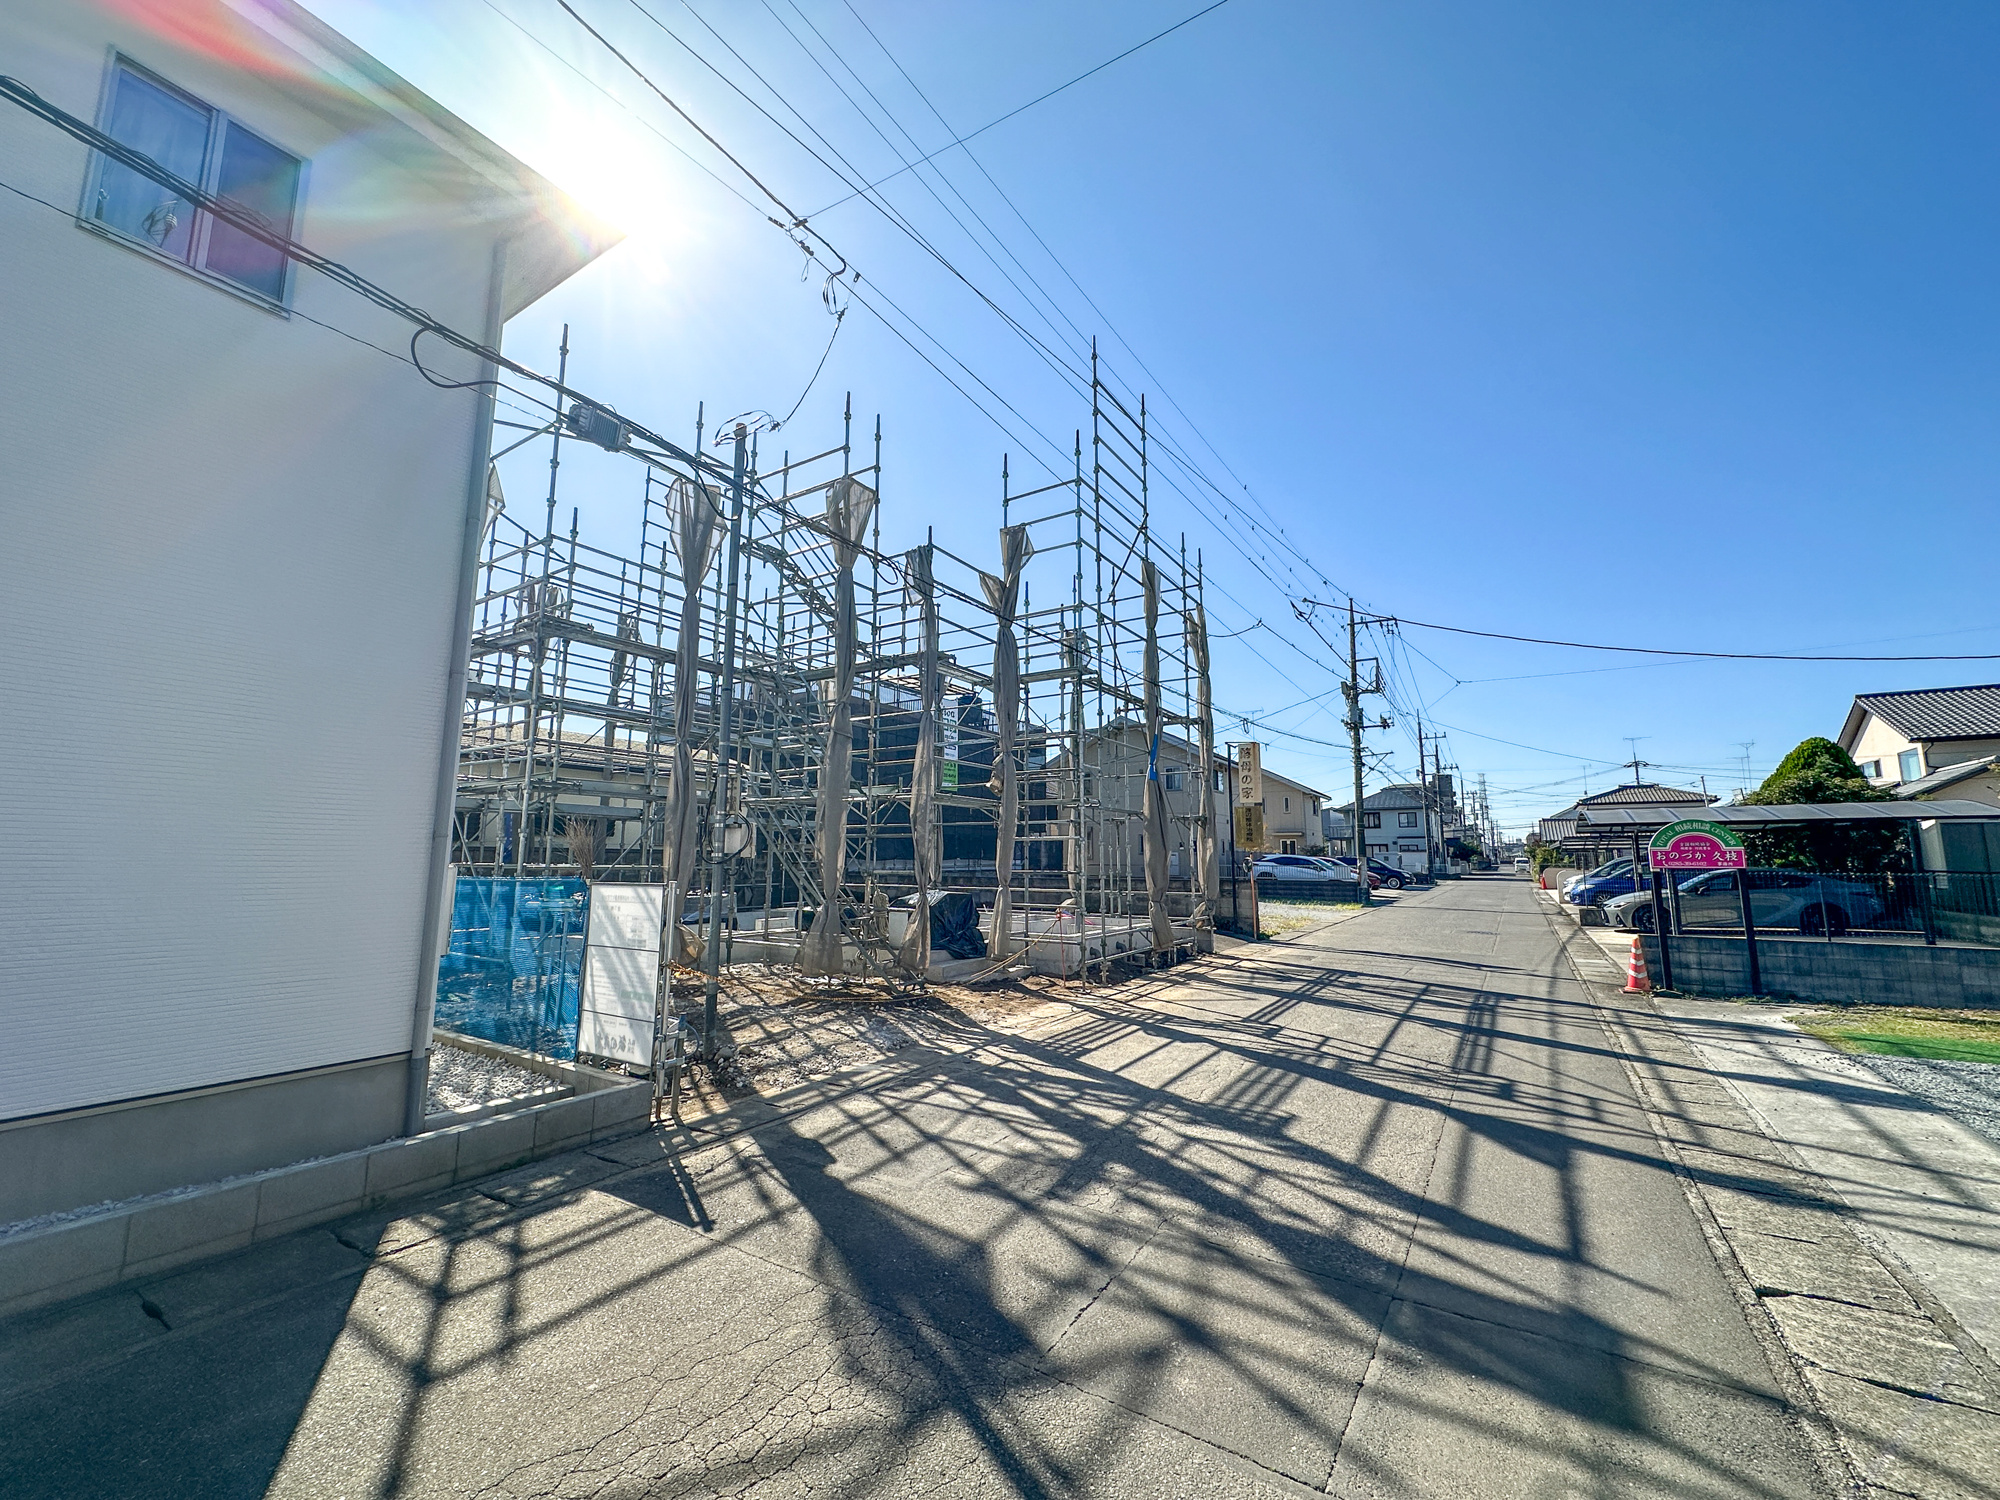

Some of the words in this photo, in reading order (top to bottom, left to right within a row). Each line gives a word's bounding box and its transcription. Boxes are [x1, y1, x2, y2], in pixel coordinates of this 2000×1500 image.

[1657, 831, 1674, 846] TOTAL
[1674, 822, 1711, 833] 相続相談
[1711, 828, 1736, 846] CENTER
[1656, 851, 1706, 860] おのづか
[1712, 851, 1739, 861] 久枝
